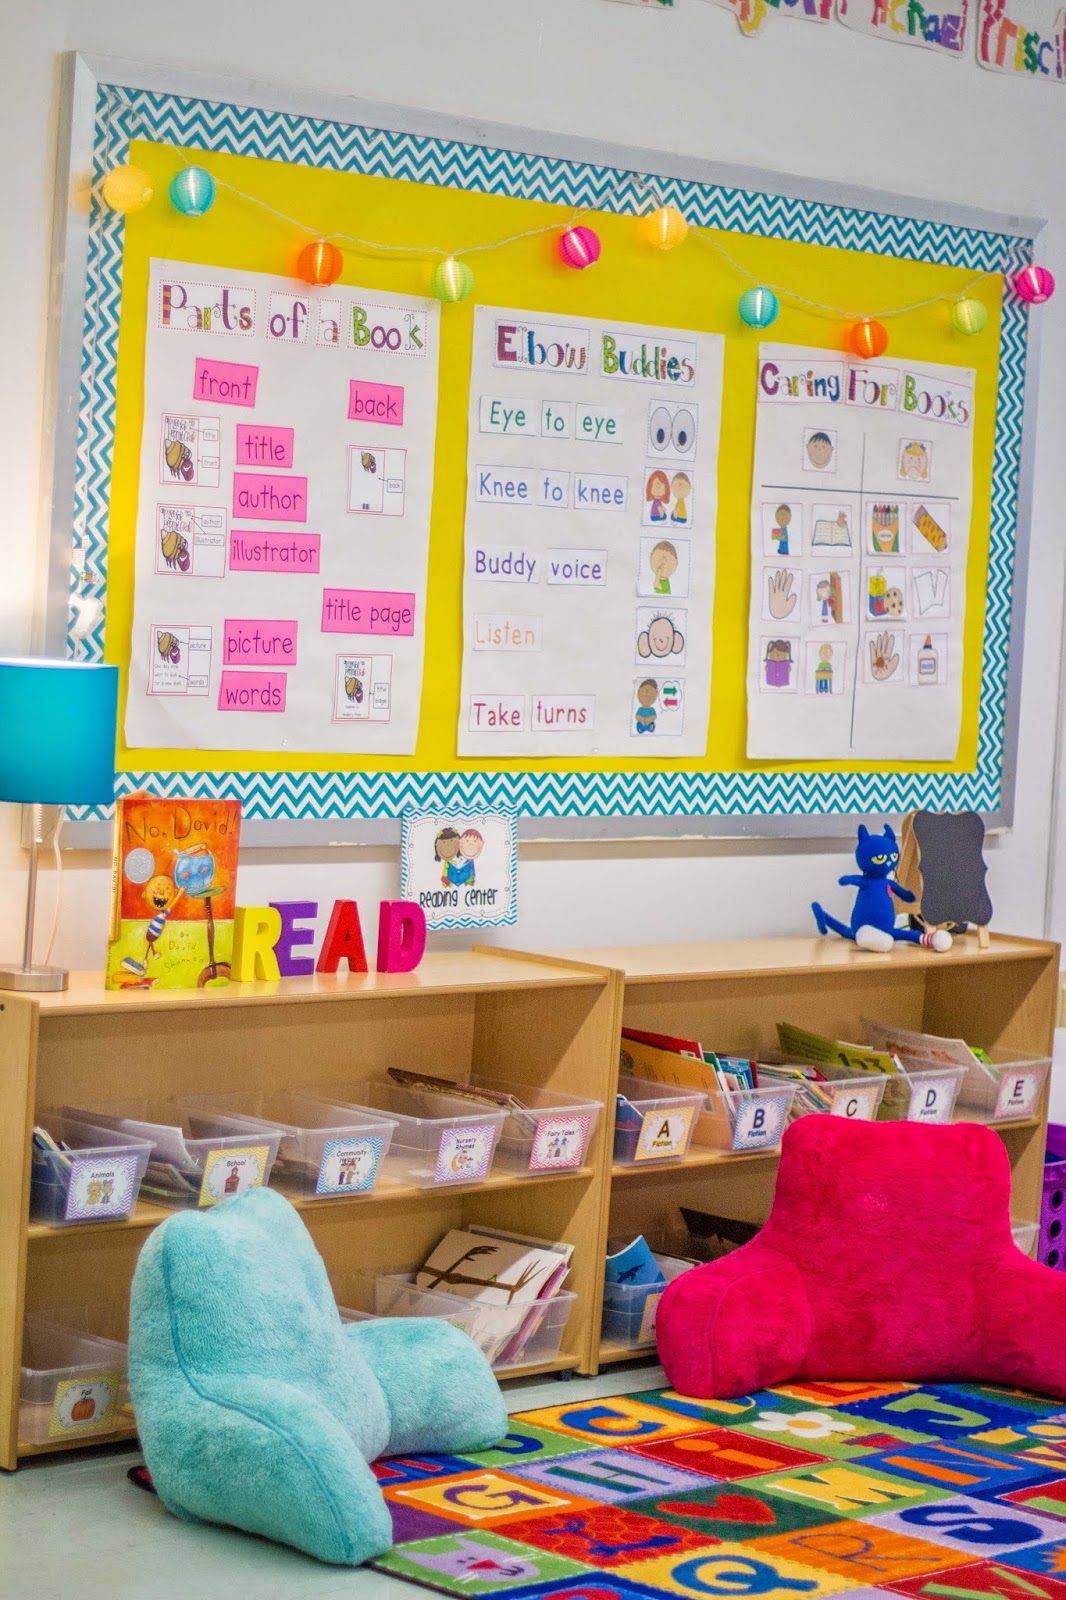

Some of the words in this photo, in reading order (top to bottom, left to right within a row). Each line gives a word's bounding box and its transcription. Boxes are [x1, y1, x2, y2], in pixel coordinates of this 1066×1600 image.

[162, 285, 252, 331] Parts
[270, 301, 307, 338] of
[321, 319, 339, 343] a
[352, 306, 424, 351] Book
[497, 325, 587, 370] Elbow
[602, 335, 694, 382] Buddies
[200, 370, 252, 400] front
[760, 362, 841, 402] Caring
[848, 369, 897, 406] For
[904, 375, 969, 424] Books
[354, 390, 398, 419] back
[490, 401, 526, 432] Eye
[545, 407, 565, 431] to
[583, 416, 617, 439] eye
[244, 434, 286, 462] title
[238, 482, 302, 511] author
[479, 472, 528, 498] Knee
[543, 478, 563, 501] to
[578, 479, 624, 504] knee
[232, 540, 317, 564] illustrator
[475, 550, 537, 582] Buddy
[551, 559, 602, 580] voice
[326, 598, 362, 622] title
[370, 606, 412, 632] page
[227, 630, 293, 661] picture
[475, 620, 535, 645] Listen
[226, 682, 282, 706] words
[473, 702, 521, 726] Take
[537, 700, 587, 724] turns
[173, 807, 238, 839] David!
[231, 899, 427, 982] READ
[925, 1089, 937, 1108] D
[1013, 1080, 1024, 1098] E
[752, 1108, 766, 1130] B
[846, 1099, 858, 1118] C
[920, 1107, 938, 1117] Fiction
[455, 1137, 477, 1145] Nursery
[547, 1130, 560, 1138] Fairy
[657, 1119, 670, 1139] A
[747, 1129, 767, 1138] Fiction
[336, 1149, 367, 1158] Community
[651, 1139, 673, 1149] Fiction
[90, 1170, 115, 1179] Animals
[226, 1159, 246, 1168] School
[81, 1388, 93, 1397] Fall
[560, 1405, 668, 1437] C
[882, 1392, 992, 1428] J
[541, 1460, 672, 1495] H
[881, 1444, 1025, 1487] N
[443, 1484, 551, 1511] G
[765, 1467, 927, 1511] M
[898, 1504, 1044, 1545] S
[787, 1532, 944, 1573] R
[670, 1554, 820, 1597] Q
